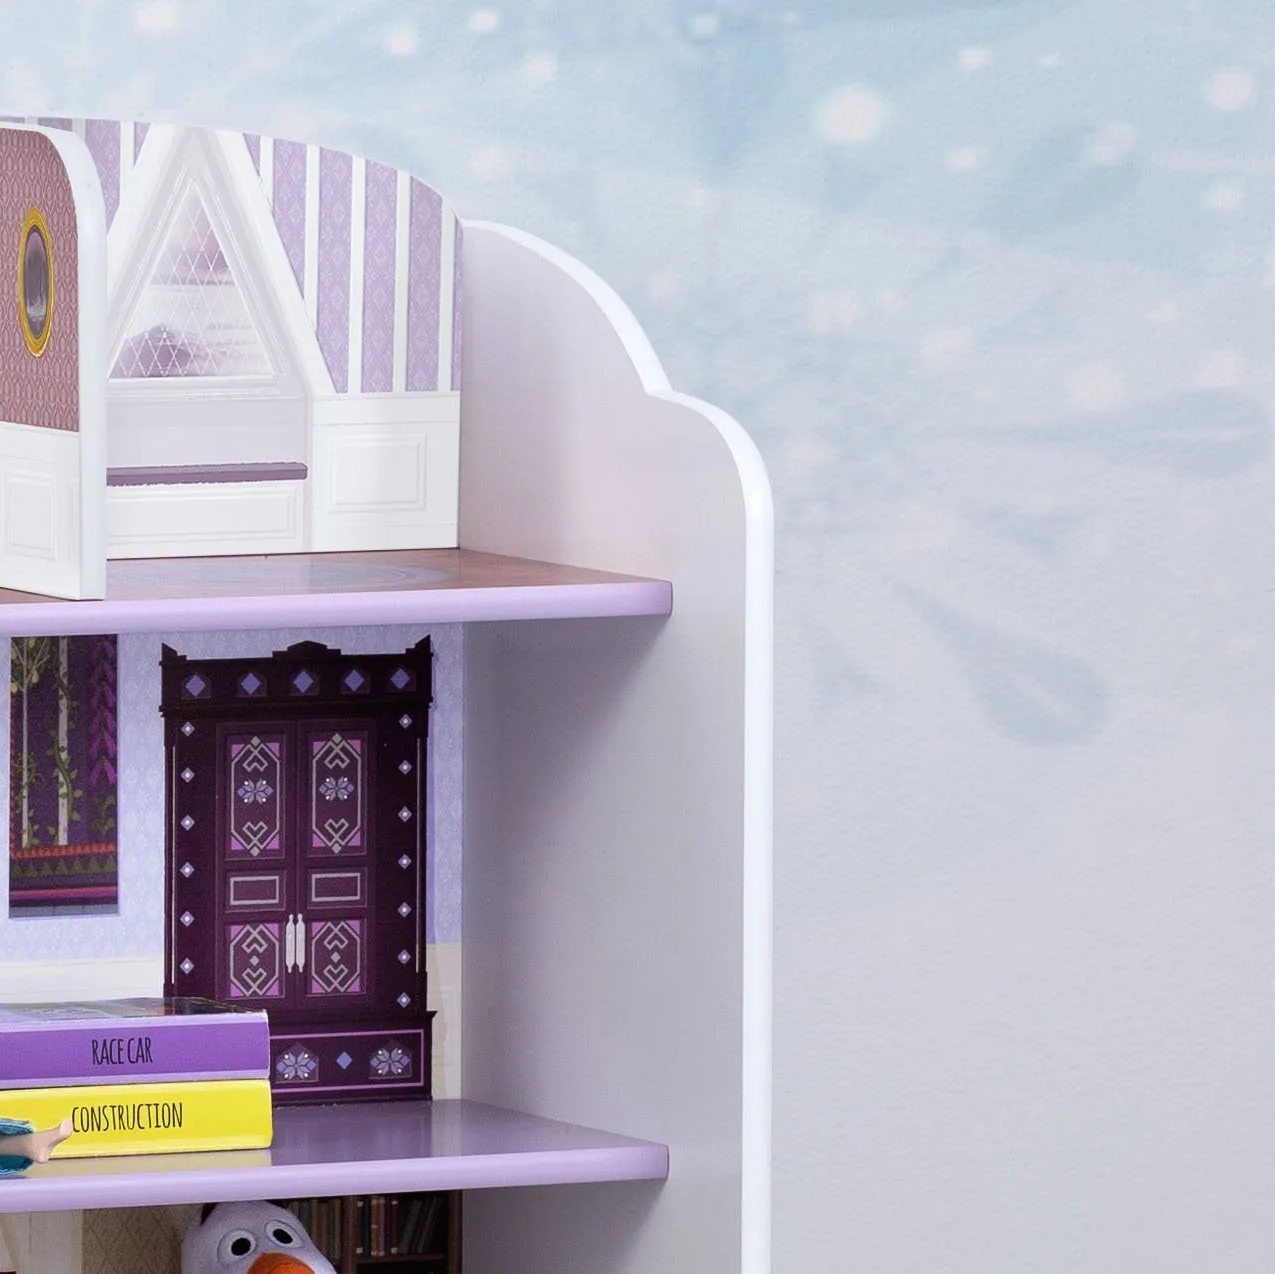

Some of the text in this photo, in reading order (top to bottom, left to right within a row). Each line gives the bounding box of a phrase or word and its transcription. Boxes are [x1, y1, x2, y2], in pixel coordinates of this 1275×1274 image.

[91, 1037, 153, 1066] RACE CAR
[72, 1102, 183, 1133] CONSTRUCTION
